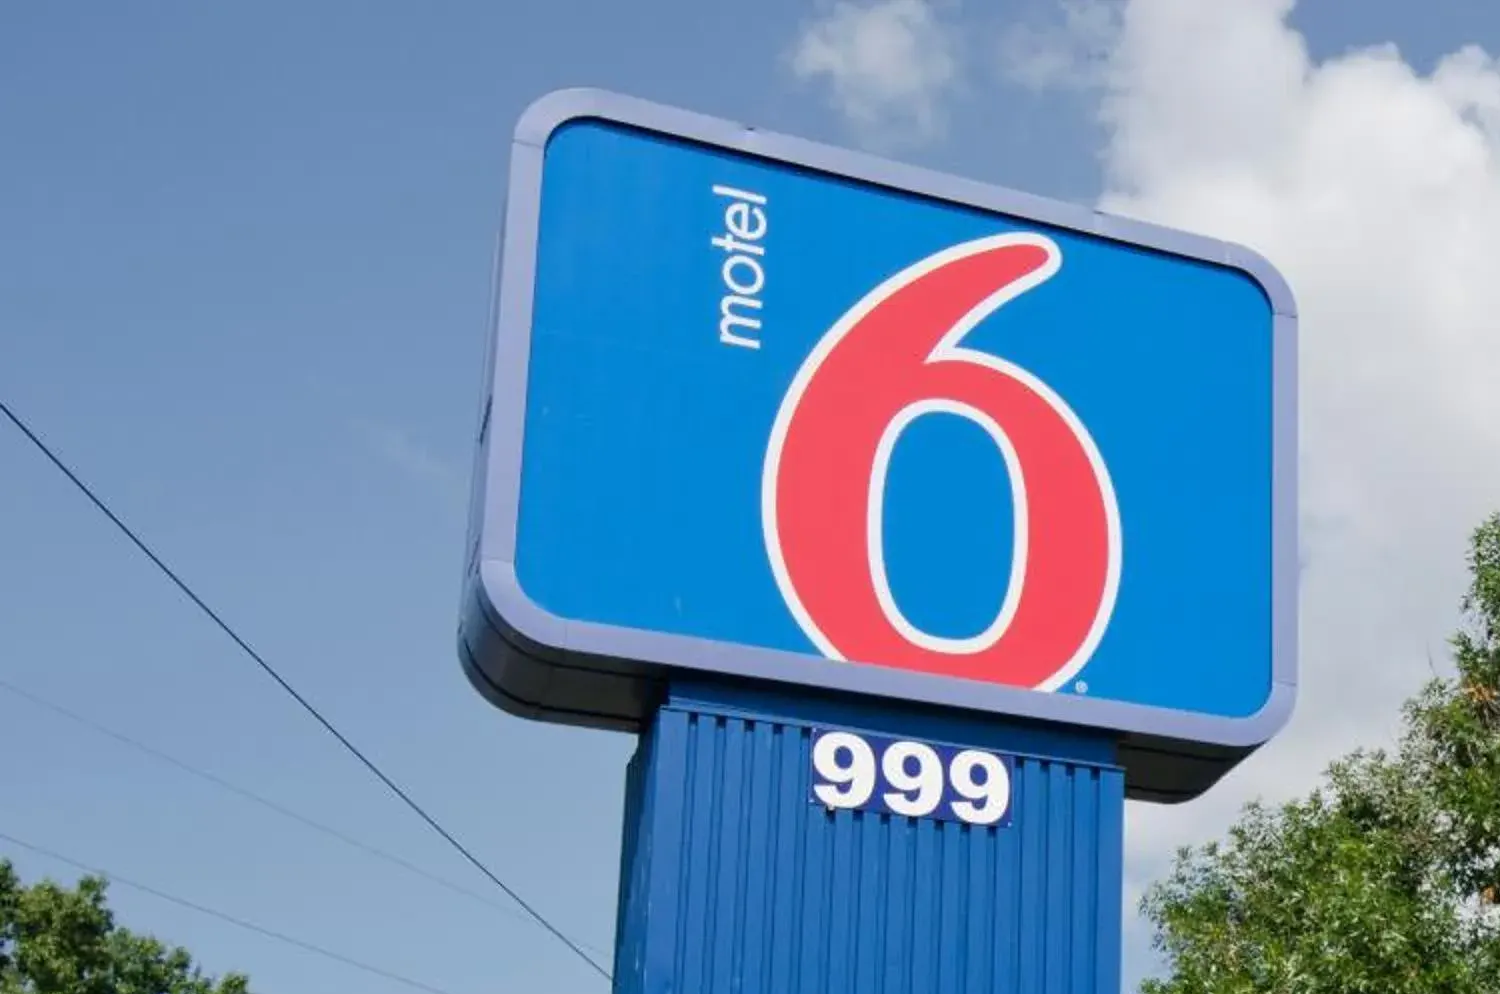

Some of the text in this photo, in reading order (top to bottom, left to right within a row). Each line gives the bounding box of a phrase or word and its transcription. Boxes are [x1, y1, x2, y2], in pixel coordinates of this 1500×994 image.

[712, 185, 767, 349] motel
[761, 232, 1122, 693] 6
[812, 732, 1010, 824] 999
